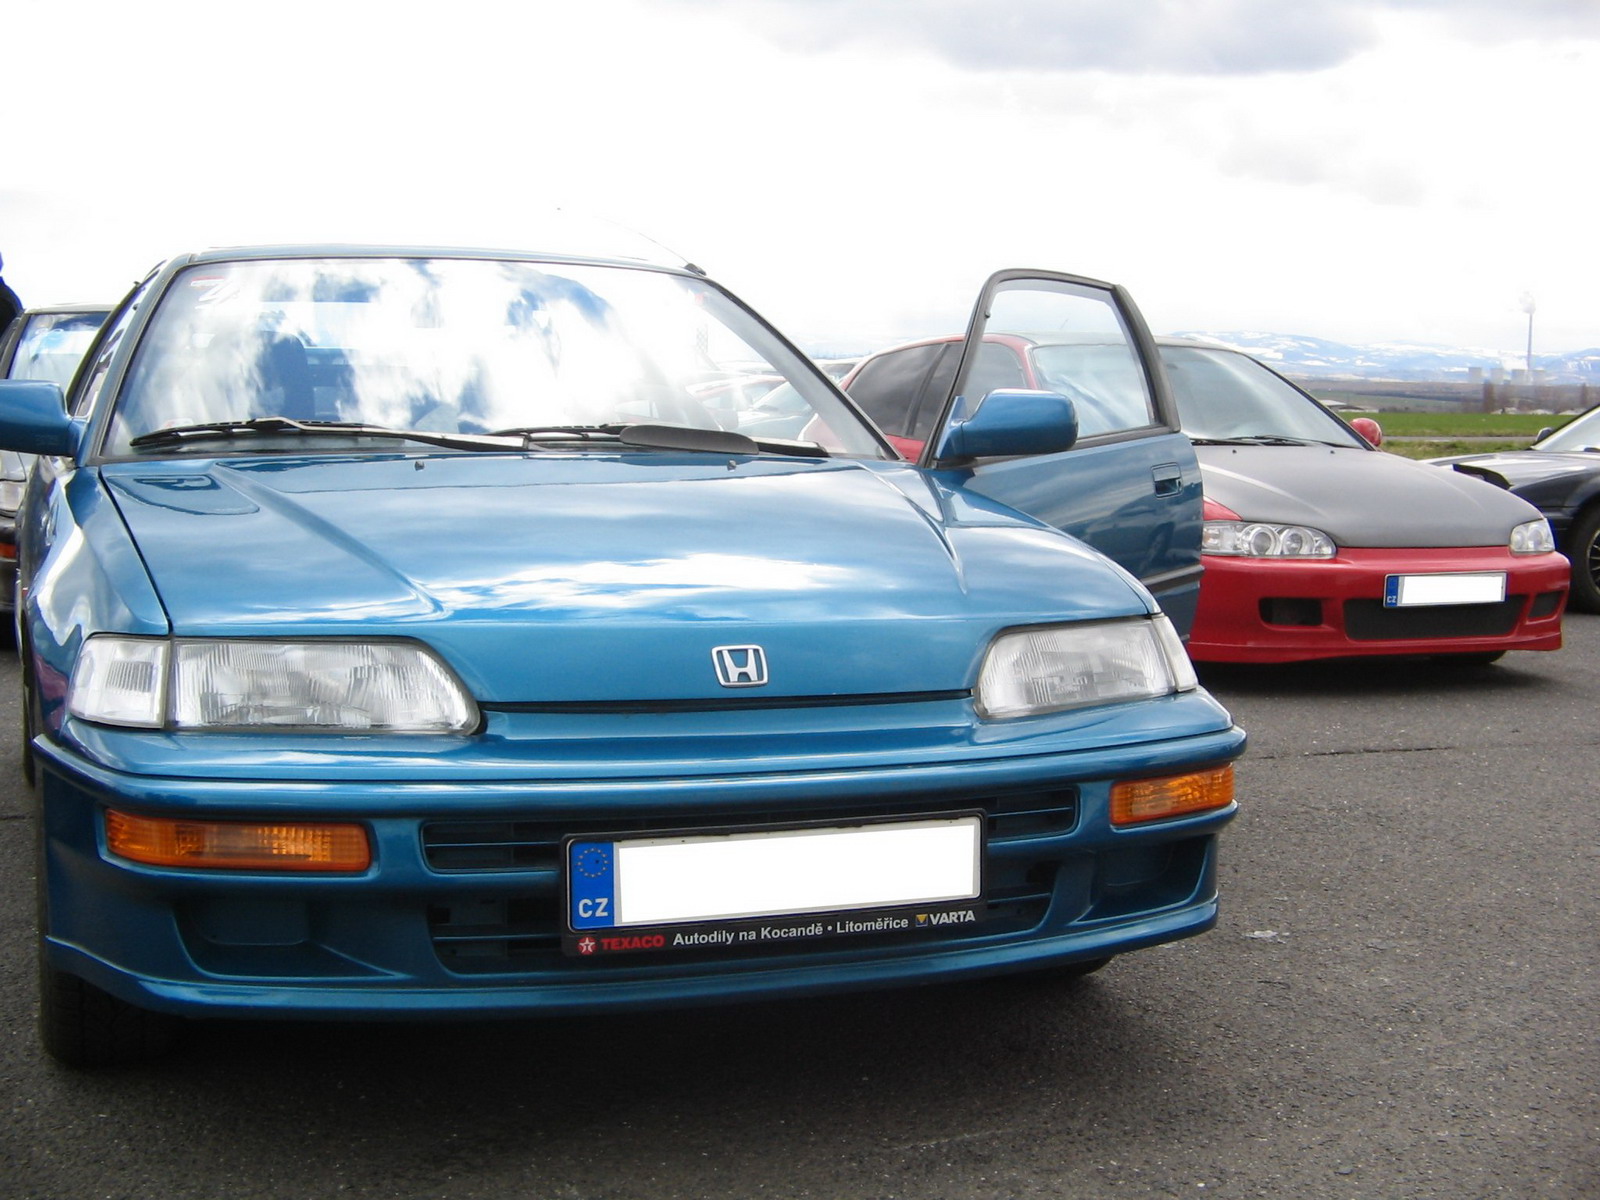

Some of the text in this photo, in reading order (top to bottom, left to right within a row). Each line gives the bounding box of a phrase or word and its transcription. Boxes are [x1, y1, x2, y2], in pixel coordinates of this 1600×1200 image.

[1386, 595, 1397, 603] CZ
[578, 898, 608, 917] CZ
[930, 910, 976, 925] VARTA
[673, 917, 909, 946] Autodíly na Kocandě Litoměřice
[601, 934, 665, 950] TEXACO
